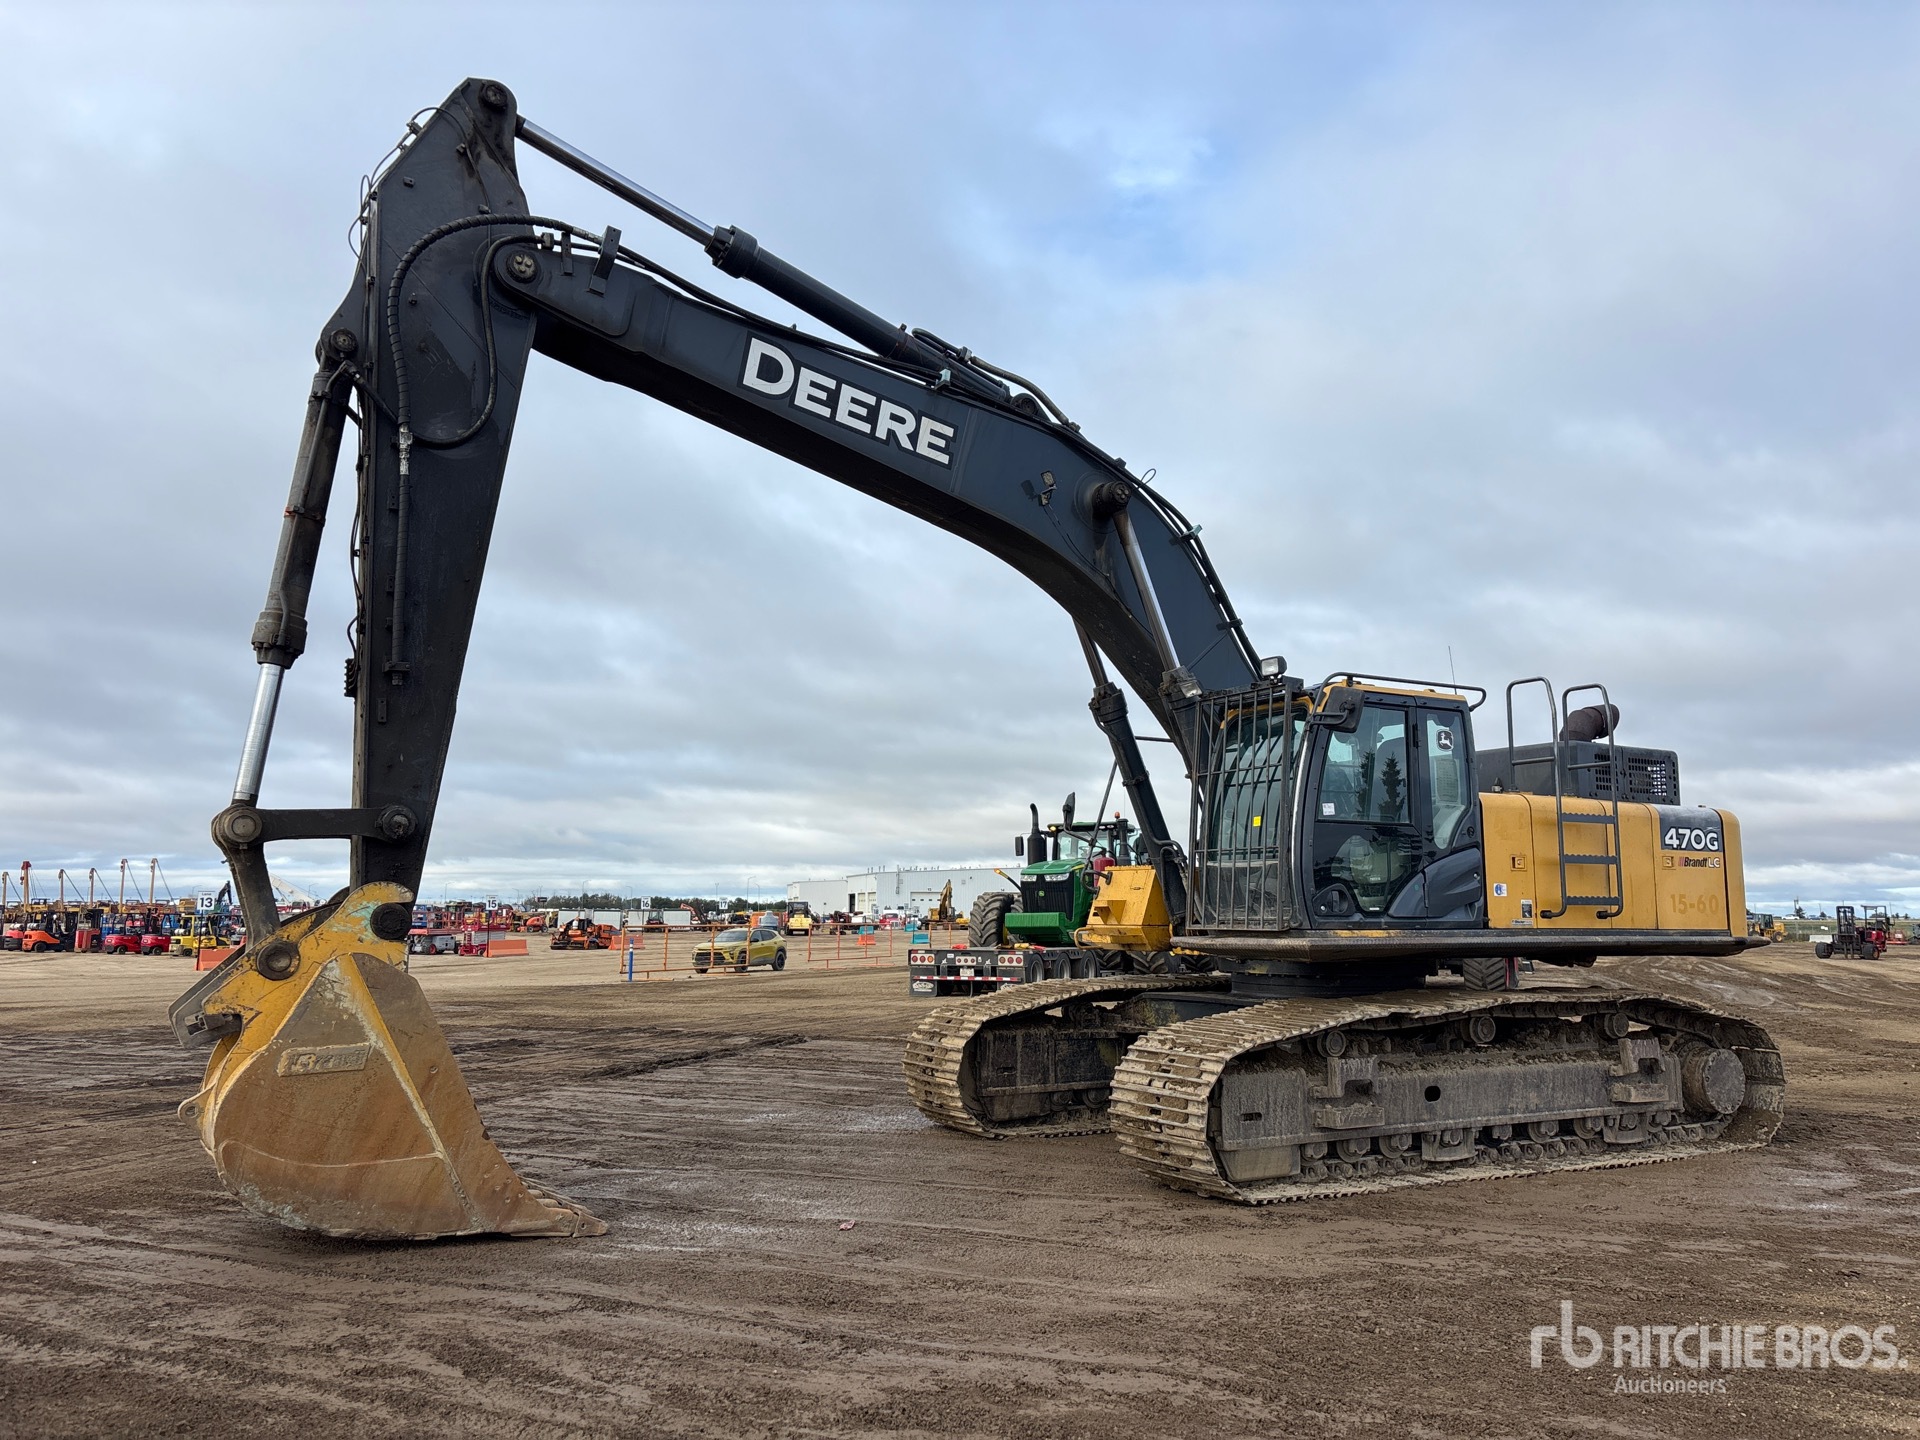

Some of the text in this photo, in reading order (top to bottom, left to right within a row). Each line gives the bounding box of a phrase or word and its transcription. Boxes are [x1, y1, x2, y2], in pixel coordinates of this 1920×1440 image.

[742, 337, 955, 465] DEERE
[1663, 827, 1720, 851] 470G
[1683, 856, 1721, 869] Brandt LC
[200, 897, 213, 908] 13
[487, 899, 497, 909] 15
[641, 900, 650, 908] 16
[1670, 894, 1720, 914] 15-60
